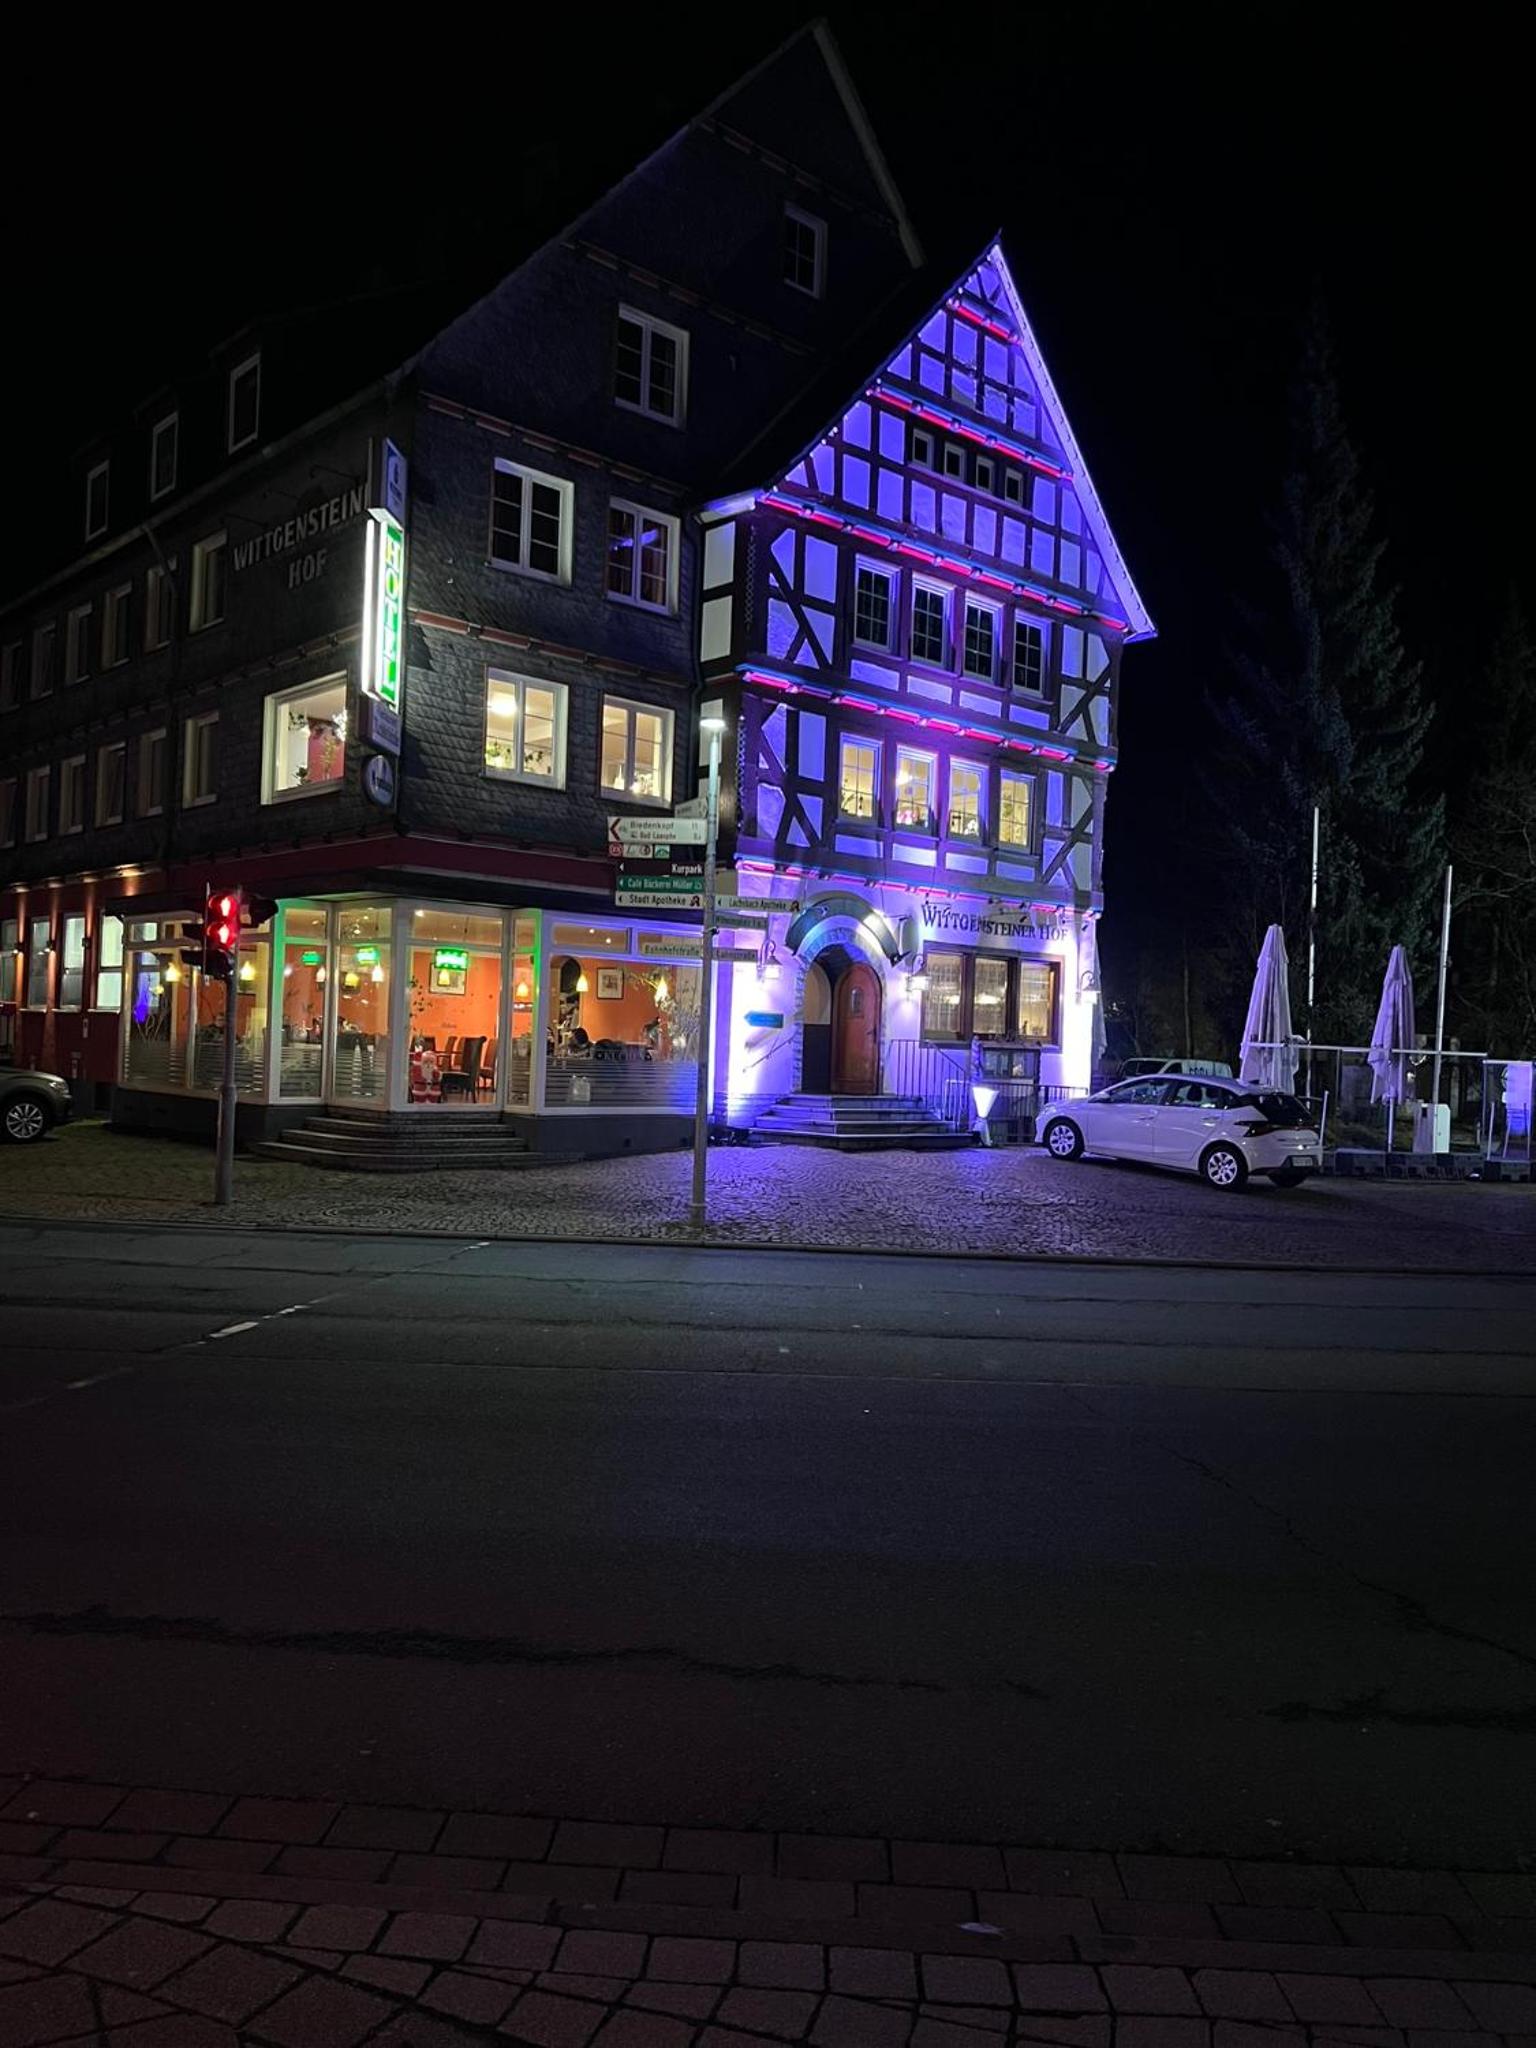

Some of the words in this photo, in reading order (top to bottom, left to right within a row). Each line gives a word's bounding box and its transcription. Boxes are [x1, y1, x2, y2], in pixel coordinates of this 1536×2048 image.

[288, 547, 328, 590] HOF
[381, 540, 400, 691] HOTEL
[630, 821, 674, 832] Biedenkopf
[671, 863, 702, 876] Kurpark
[630, 894, 650, 904] Stadt
[652, 895, 686, 907] Apotheke
[921, 905, 1036, 939] WITTGENSTEINER
[1040, 925, 1068, 941] HOF
